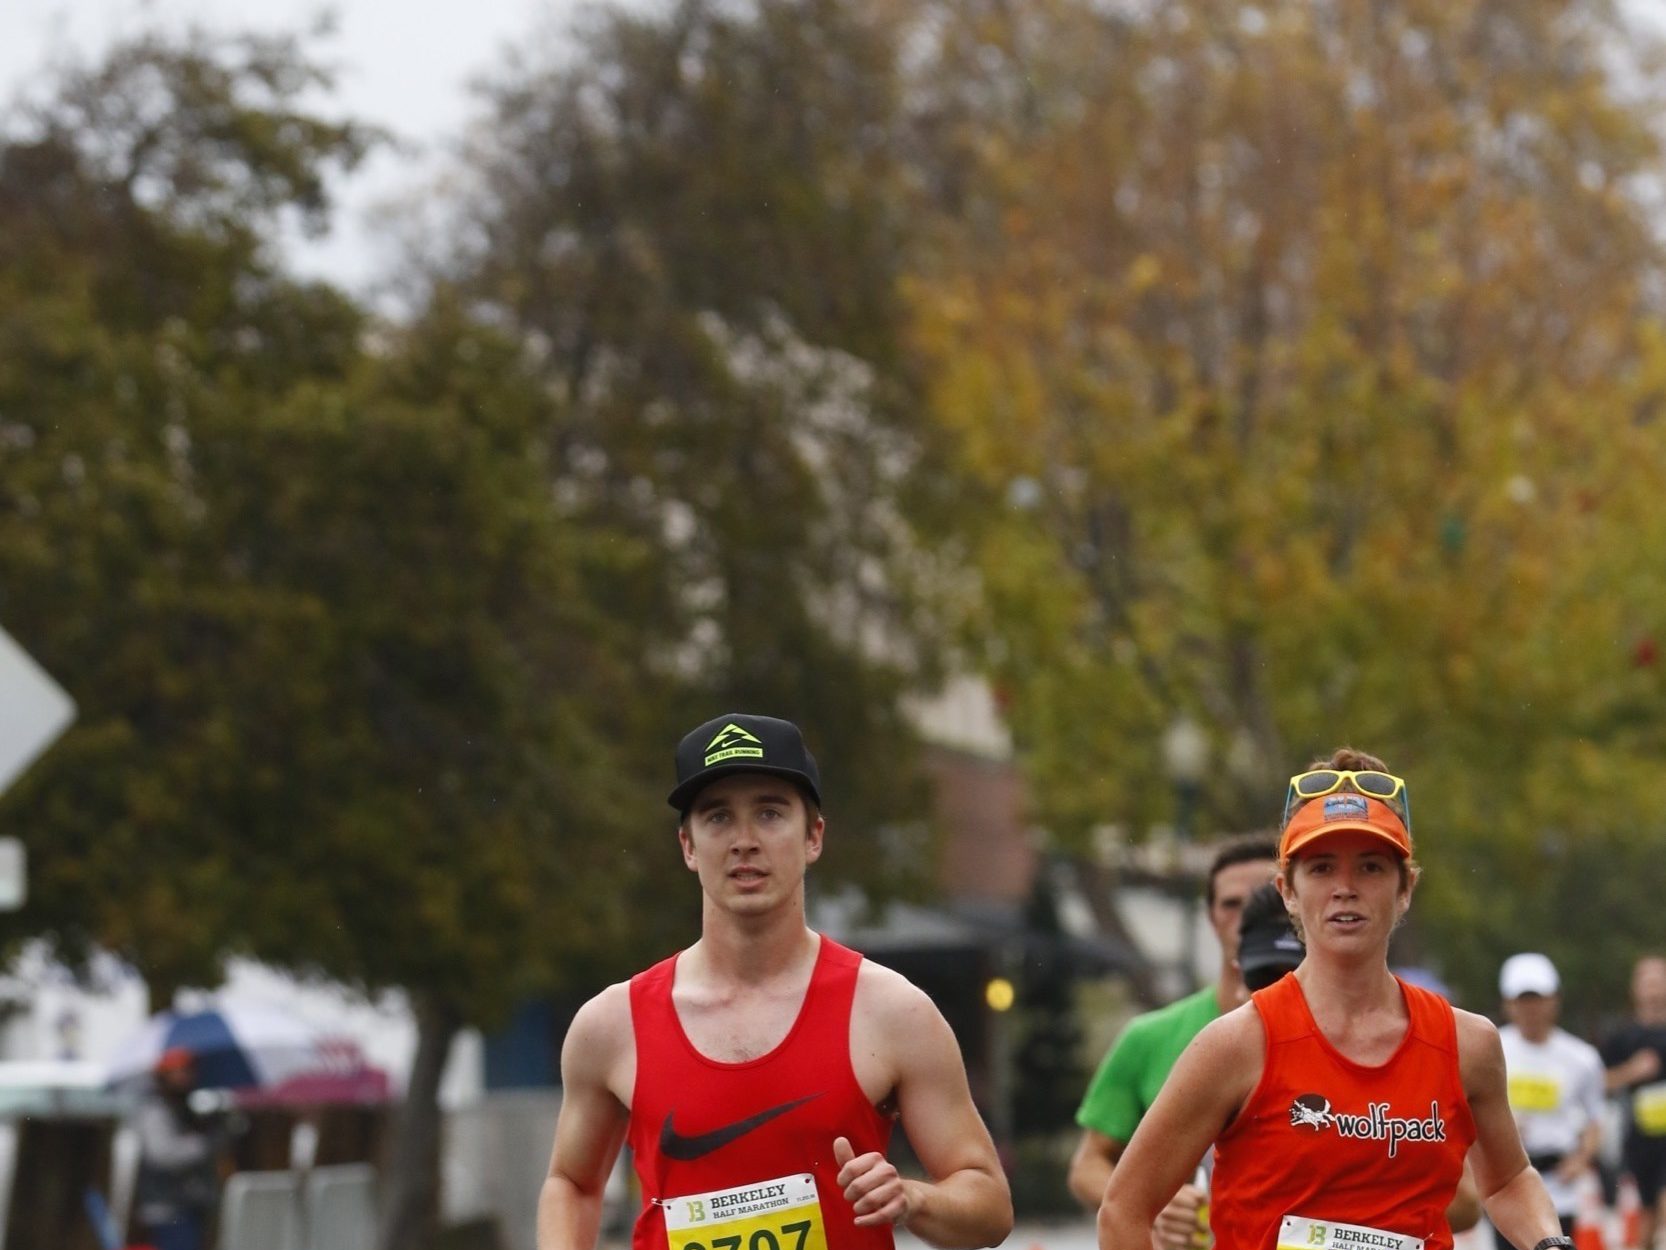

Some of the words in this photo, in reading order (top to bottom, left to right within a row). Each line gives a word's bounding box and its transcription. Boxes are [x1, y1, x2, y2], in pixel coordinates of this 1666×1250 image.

[1335, 1100, 1446, 1158] wolfpack
[710, 1184, 786, 1209] BERKELEY
[713, 1208, 736, 1219] HALF
[738, 1197, 789, 1214] MARATHON
[1332, 1241, 1355, 1250] HALF
[1334, 1228, 1403, 1250] BERKELEY
